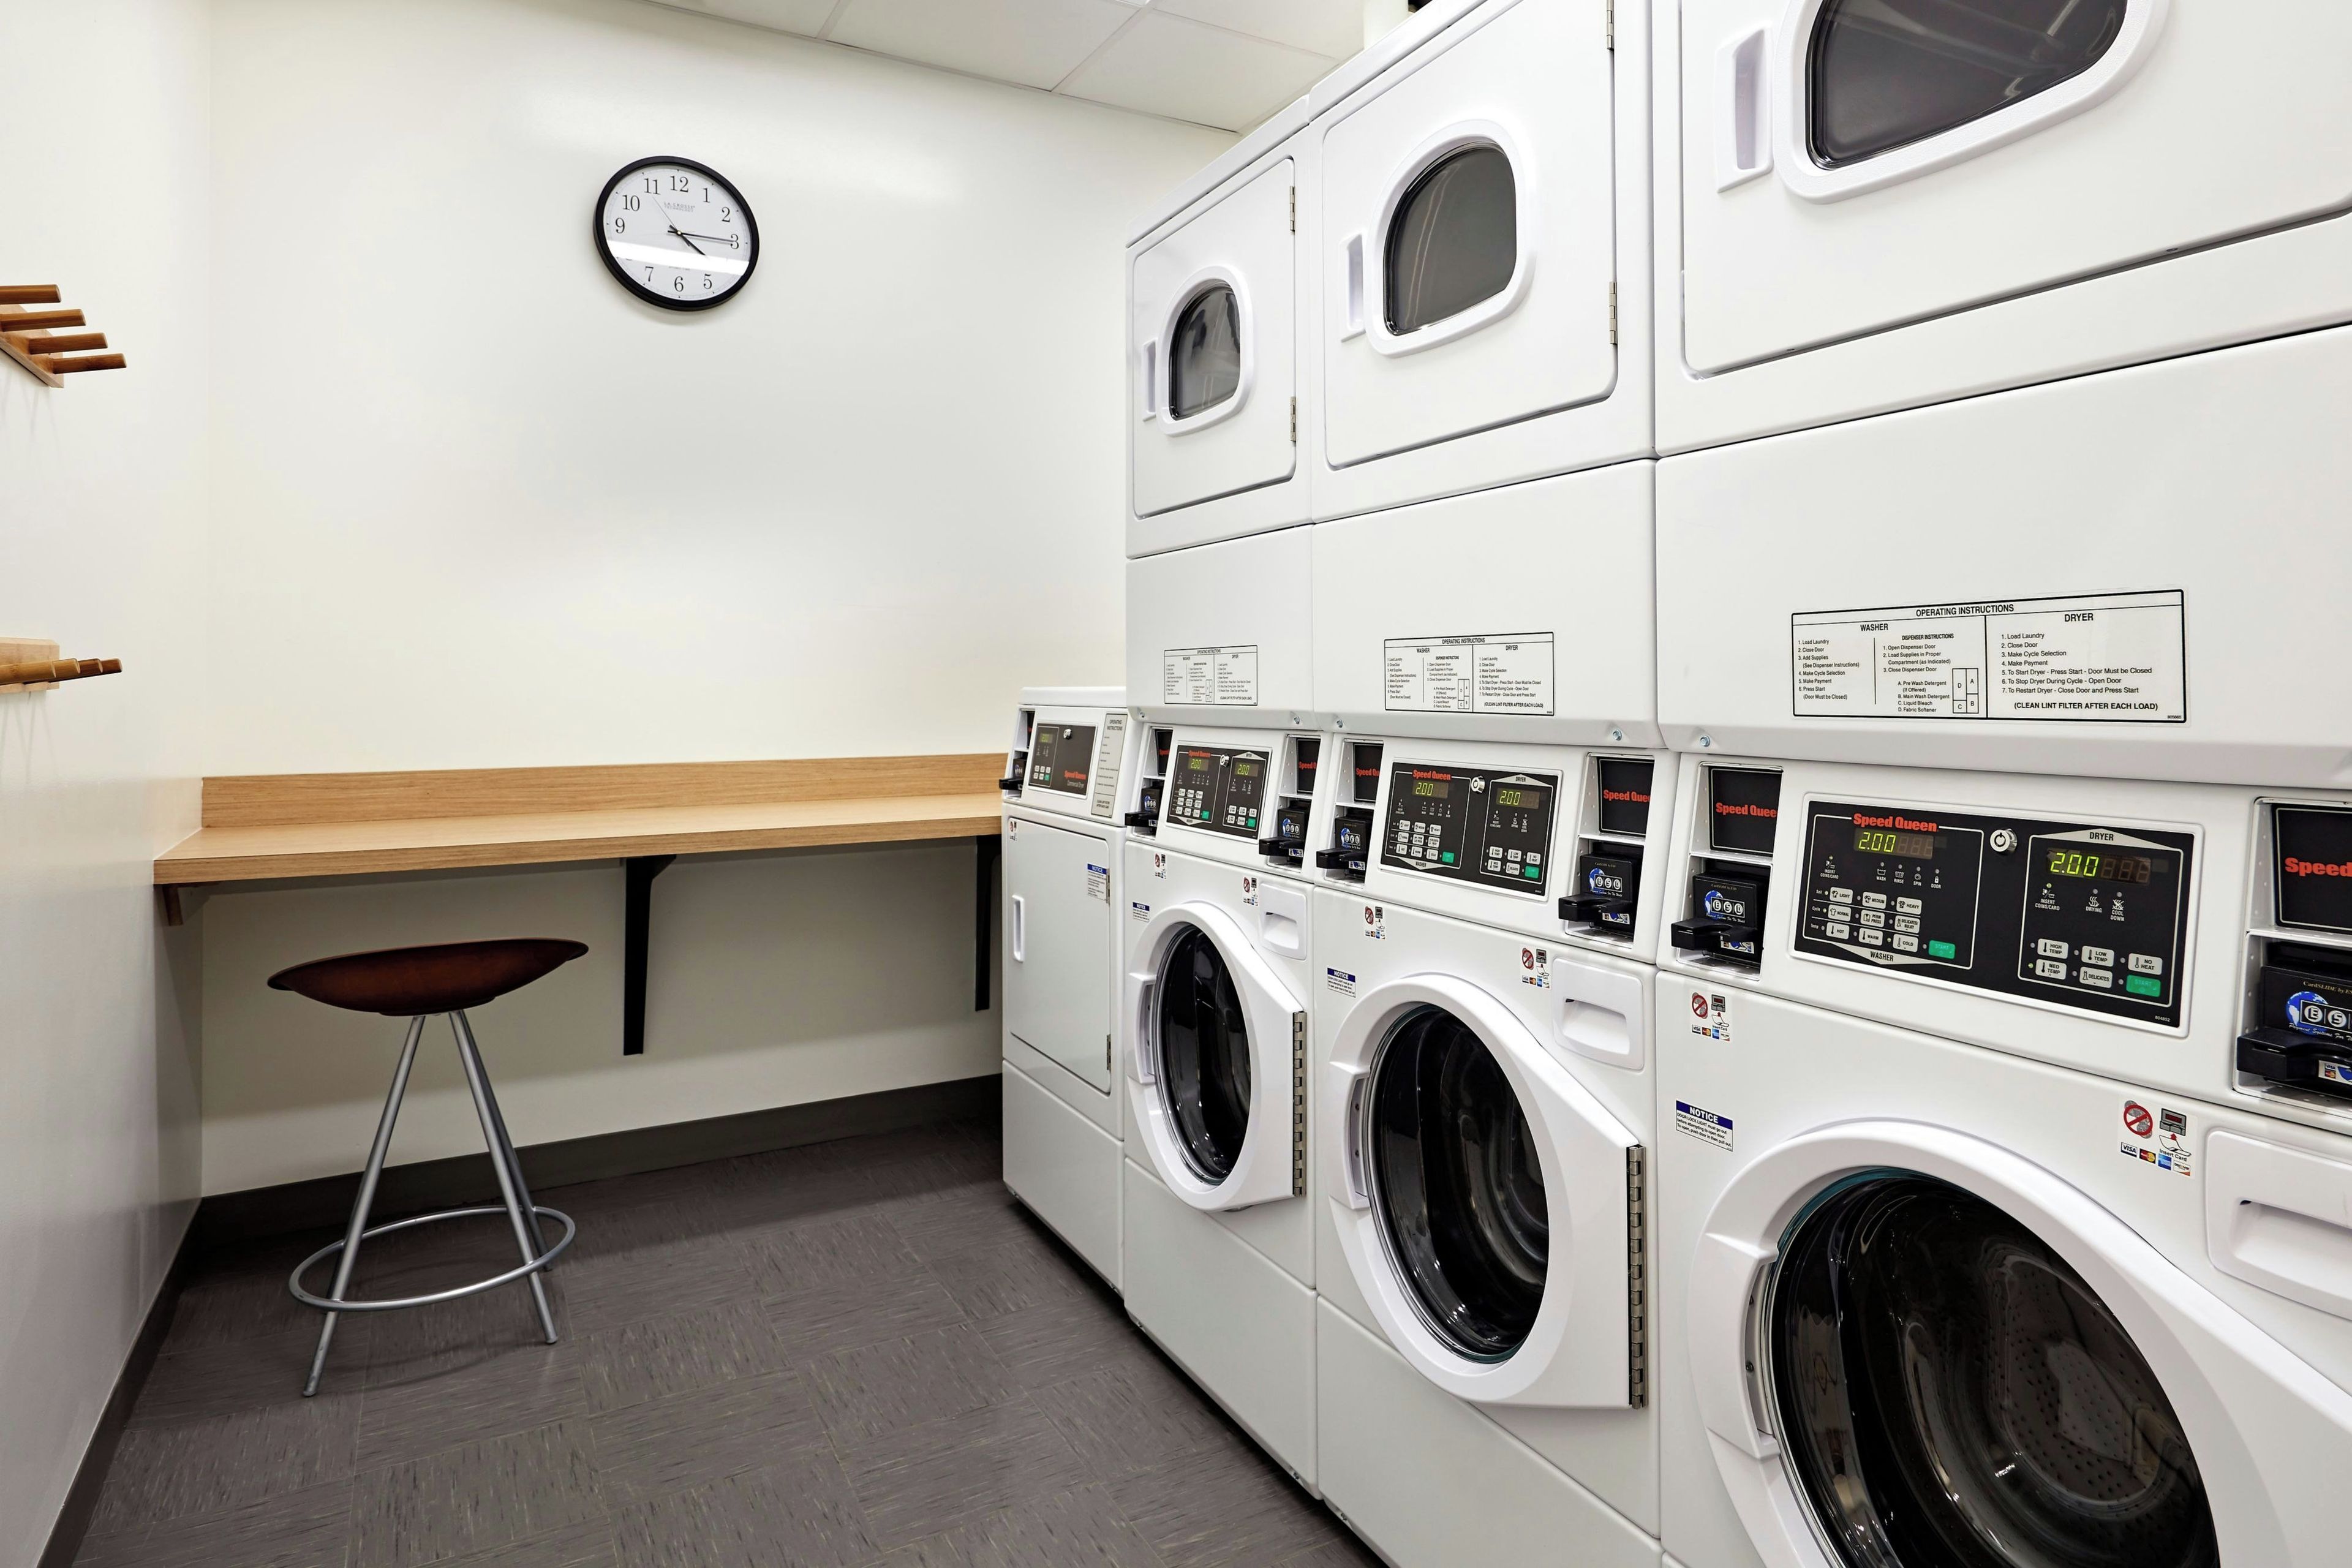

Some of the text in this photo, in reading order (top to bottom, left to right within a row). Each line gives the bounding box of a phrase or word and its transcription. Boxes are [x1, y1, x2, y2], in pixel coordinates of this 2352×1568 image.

[643, 178, 661, 195] 11
[669, 175, 689, 193] 12
[703, 187, 710, 203] 1
[622, 194, 641, 212] 10
[721, 206, 731, 222] 2
[615, 217, 625, 234] 9
[730, 233, 739, 250] 3
[644, 266, 654, 282] 7
[674, 276, 684, 292] 6
[703, 274, 712, 290] 5
[1915, 604, 2015, 617] OPERATING INSTRUCTIONS
[2064, 612, 2094, 622] DRYER
[1860, 622, 1889, 632] WASHER
[2088, 677, 2105, 685] Open
[2133, 703, 2158, 712] LOAD)
[1237, 764, 1250, 775] 2.00
[1298, 761, 1313, 770] Speed
[1355, 767, 1372, 777] Speed
[1412, 769, 1452, 780] Speed Queen
[1415, 782, 1434, 796] 2.00
[1603, 789, 1651, 802] Speed Que
[1499, 790, 1521, 805] 2.00
[1715, 802, 1777, 818] Speed Quee
[1853, 813, 1938, 832] Speed Queen
[1858, 832, 1896, 853] 2.00
[2089, 832, 2114, 841] DRYER
[2050, 853, 2099, 877] 2.00
[2285, 857, 2352, 878] Speed
[1870, 951, 1894, 962] WASHER
[1333, 970, 1349, 980] NOTICE
[1689, 1106, 1719, 1123] NOTICE
[1687, 1122, 1704, 1132] attempting
[2122, 1144, 2137, 1153] VISA
[2159, 1148, 2174, 1158] Insert
